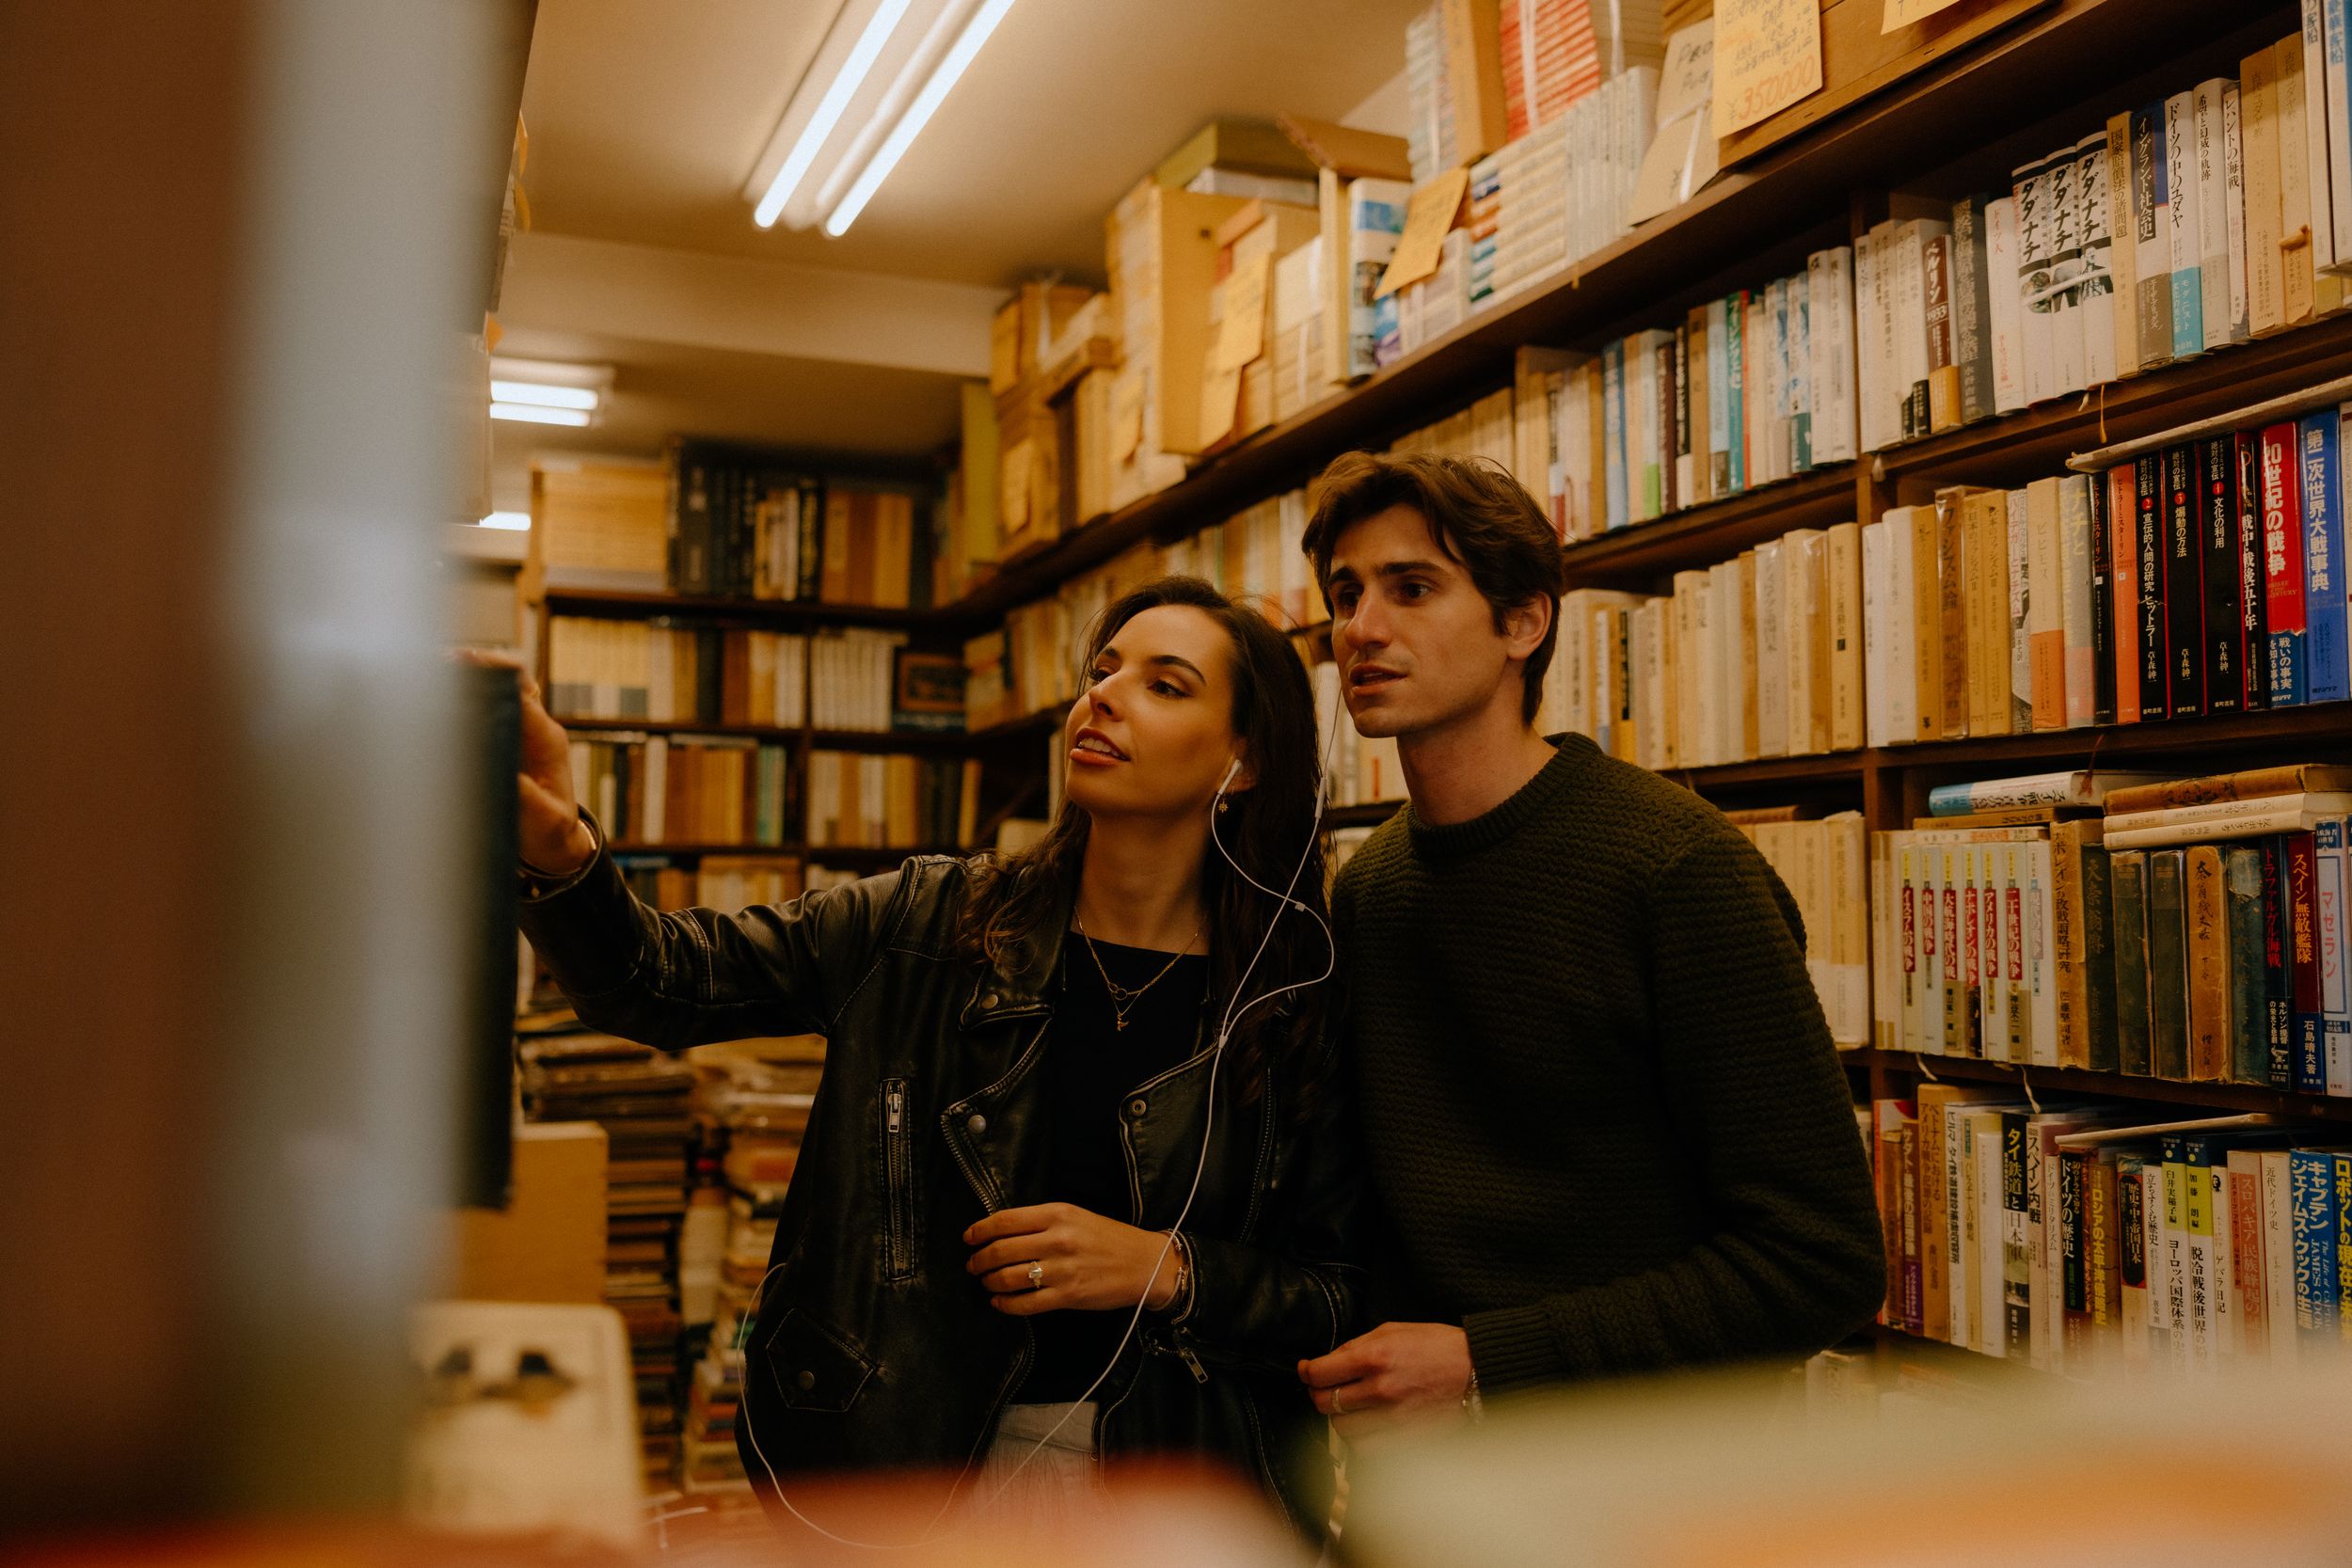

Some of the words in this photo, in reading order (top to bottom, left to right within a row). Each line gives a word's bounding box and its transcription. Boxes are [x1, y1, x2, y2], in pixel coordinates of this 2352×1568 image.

[2137, 117, 2153, 240] イングランド社会史
[2169, 103, 2184, 228] ドイツの中のユダヤ
[1925, 242, 1941, 304] ベルリン
[2214, 497, 2225, 549] 文化の利用
[2263, 442, 2286, 577] 20世紀の戦争
[2306, 429, 2329, 593] 第二次世界大戦事典
[2142, 513, 2155, 593] 宣伝的人間の研究
[2143, 594, 2158, 647] ヒットラー
[2268, 639, 2280, 690] を知る事典
[2279, 637, 2293, 689] 戦いの事実
[1965, 890, 1979, 985] ナポレオンの戦争
[1984, 892, 1997, 976] アメリカの戦争
[2263, 847, 2281, 969] トラファルガル海戦
[2293, 853, 2313, 964] スペイン無敵艦隊
[2321, 892, 2337, 979] マゼラン
[2278, 1000, 2289, 1045] ネルソン提督
[2303, 1019, 2317, 1074] 石島晴夫著
[2008, 1128, 2024, 1261] タイ鉄道と日本軍
[2027, 1136, 2042, 1225] スペイン内戦
[2060, 1158, 2075, 1259] ドイツの歴史
[2147, 1173, 2159, 1246] 立ちすくむ歴史
[2265, 1166, 2279, 1231] 近代ドイツ史
[2308, 1161, 2329, 1230] キャプテン
[2215, 1255, 2227, 1314] ゲバラ日記
[2311, 1238, 2322, 1288] JAMES
